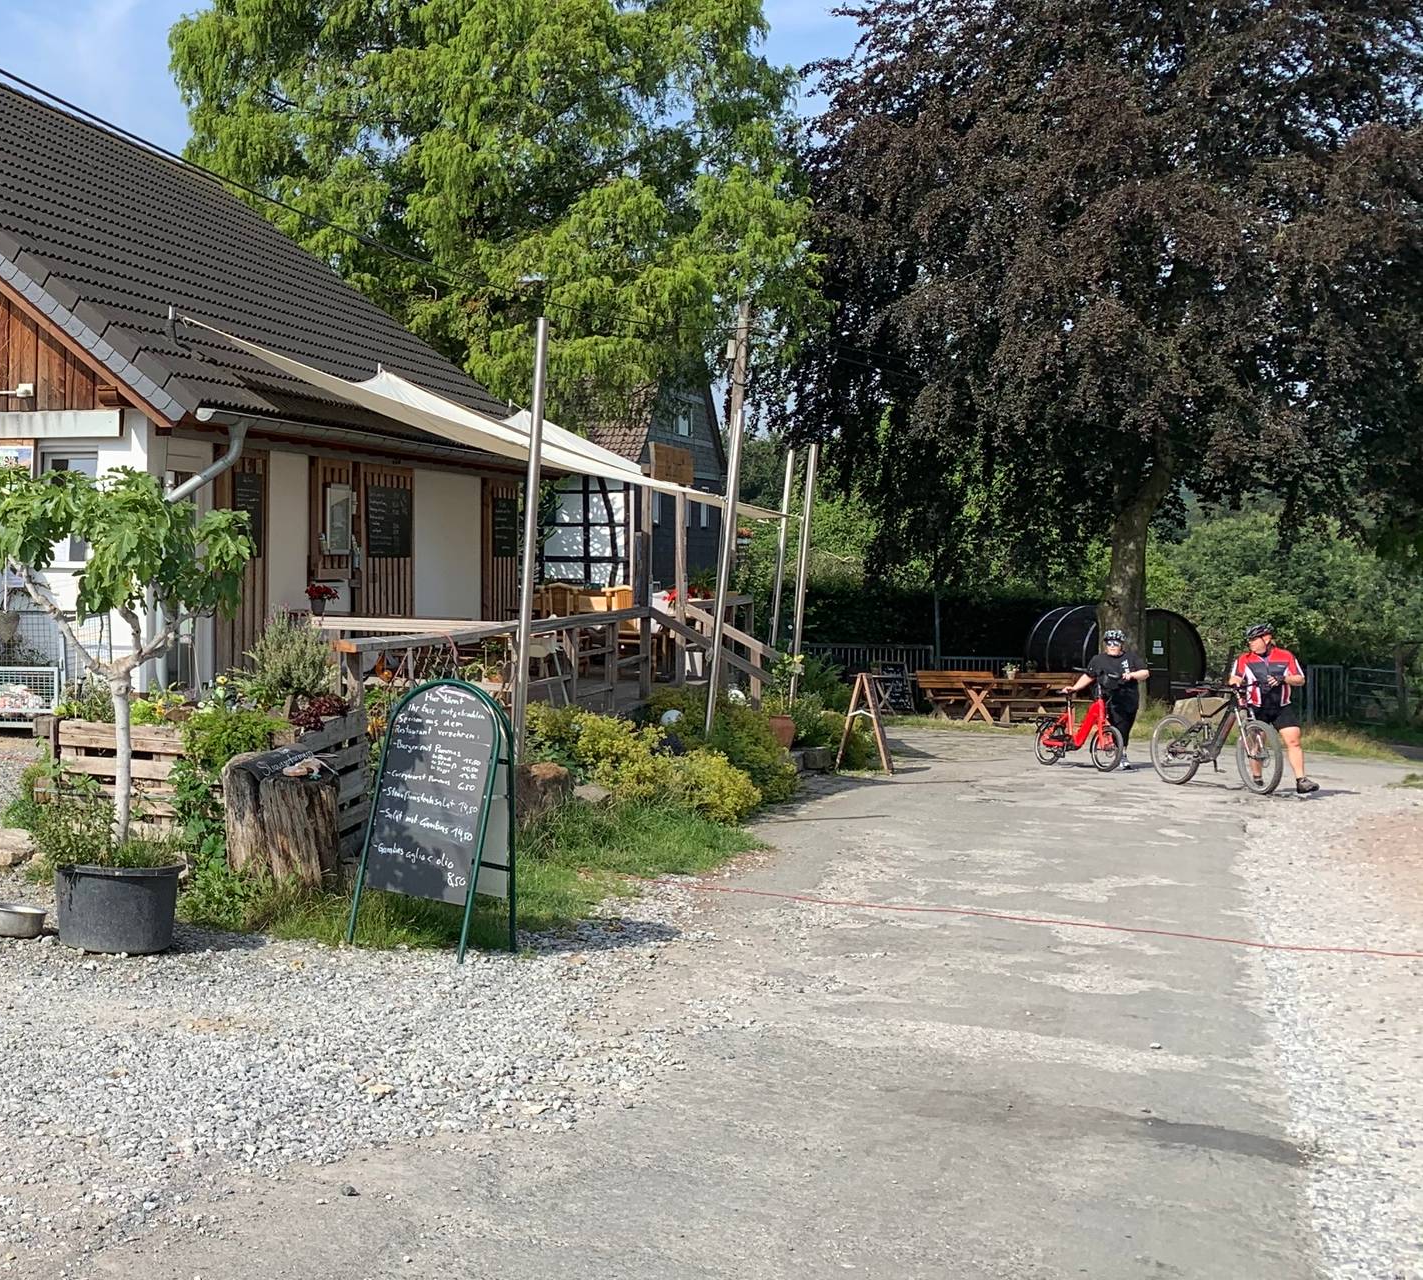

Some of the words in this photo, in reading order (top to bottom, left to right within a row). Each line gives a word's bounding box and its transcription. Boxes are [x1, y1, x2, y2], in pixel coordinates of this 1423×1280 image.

[408, 703, 420, 713] Ihr
[443, 719, 464, 727] dem
[394, 724, 433, 736] Restaurant
[405, 814, 419, 824] mit
[436, 853, 455, 869] olio
